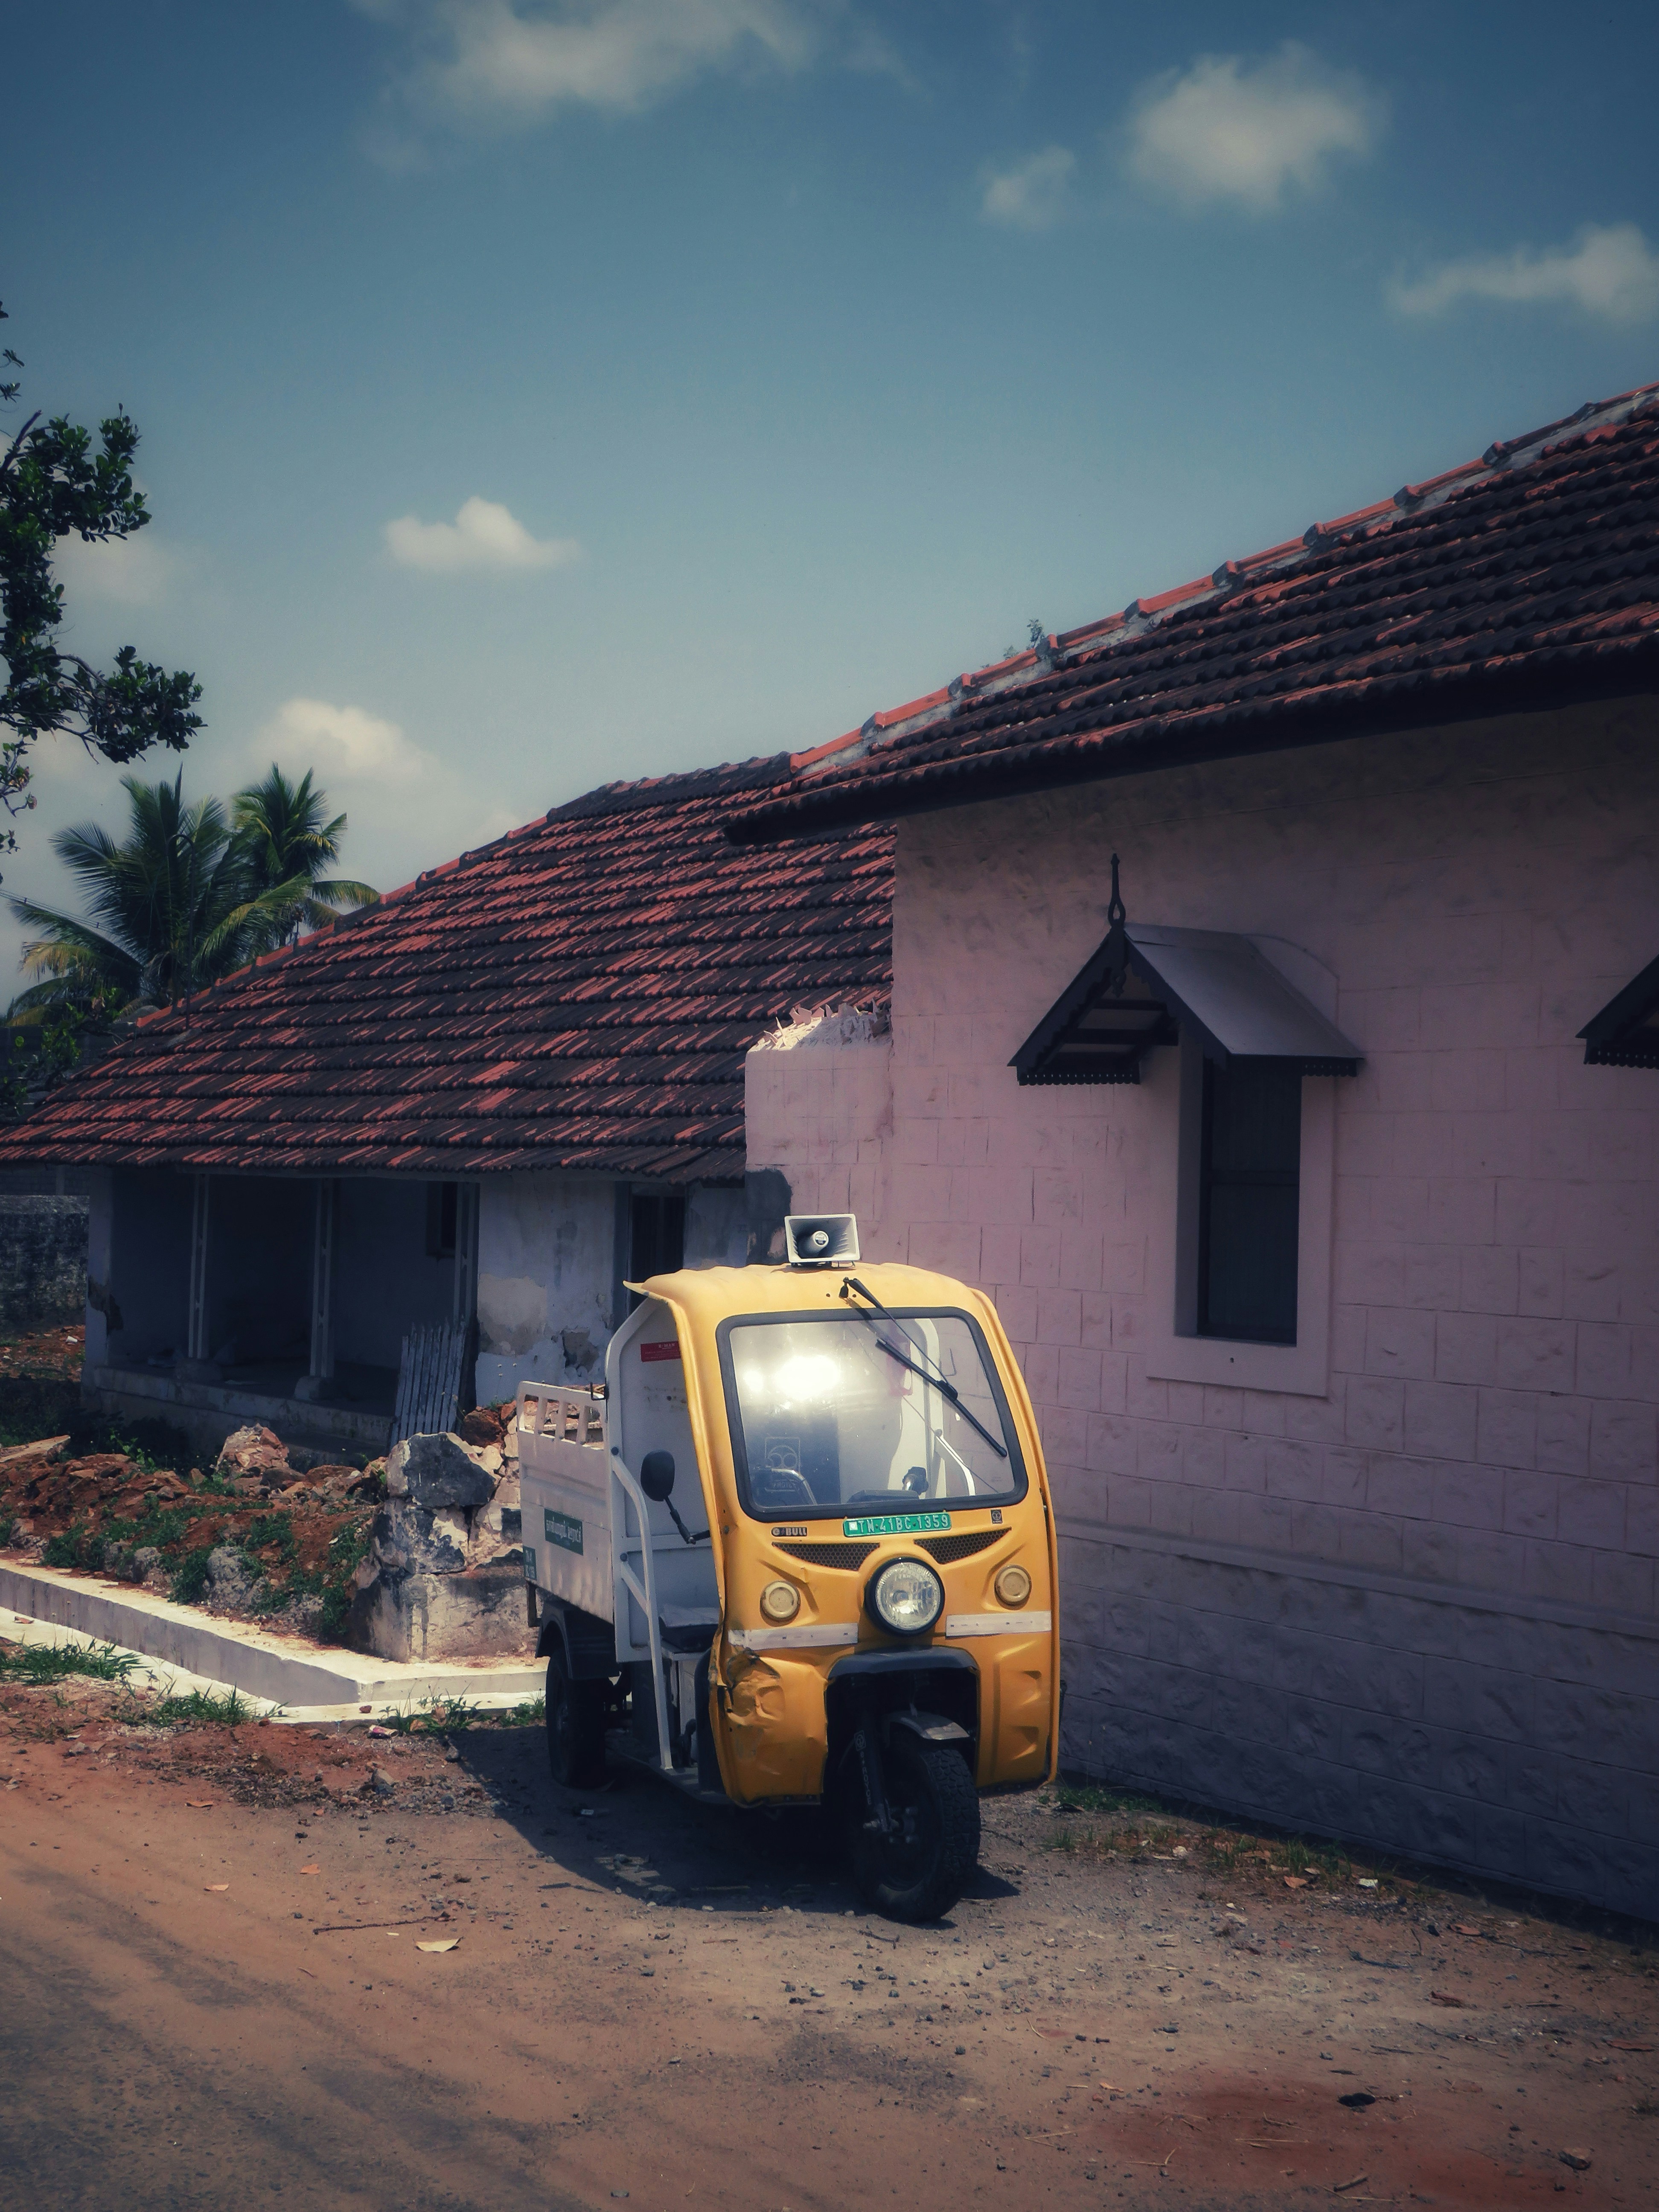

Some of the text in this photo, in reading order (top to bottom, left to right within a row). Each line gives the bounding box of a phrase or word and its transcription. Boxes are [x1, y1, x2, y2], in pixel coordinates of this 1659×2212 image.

[858, 1515, 949, 1533] TN 41BC 1359
